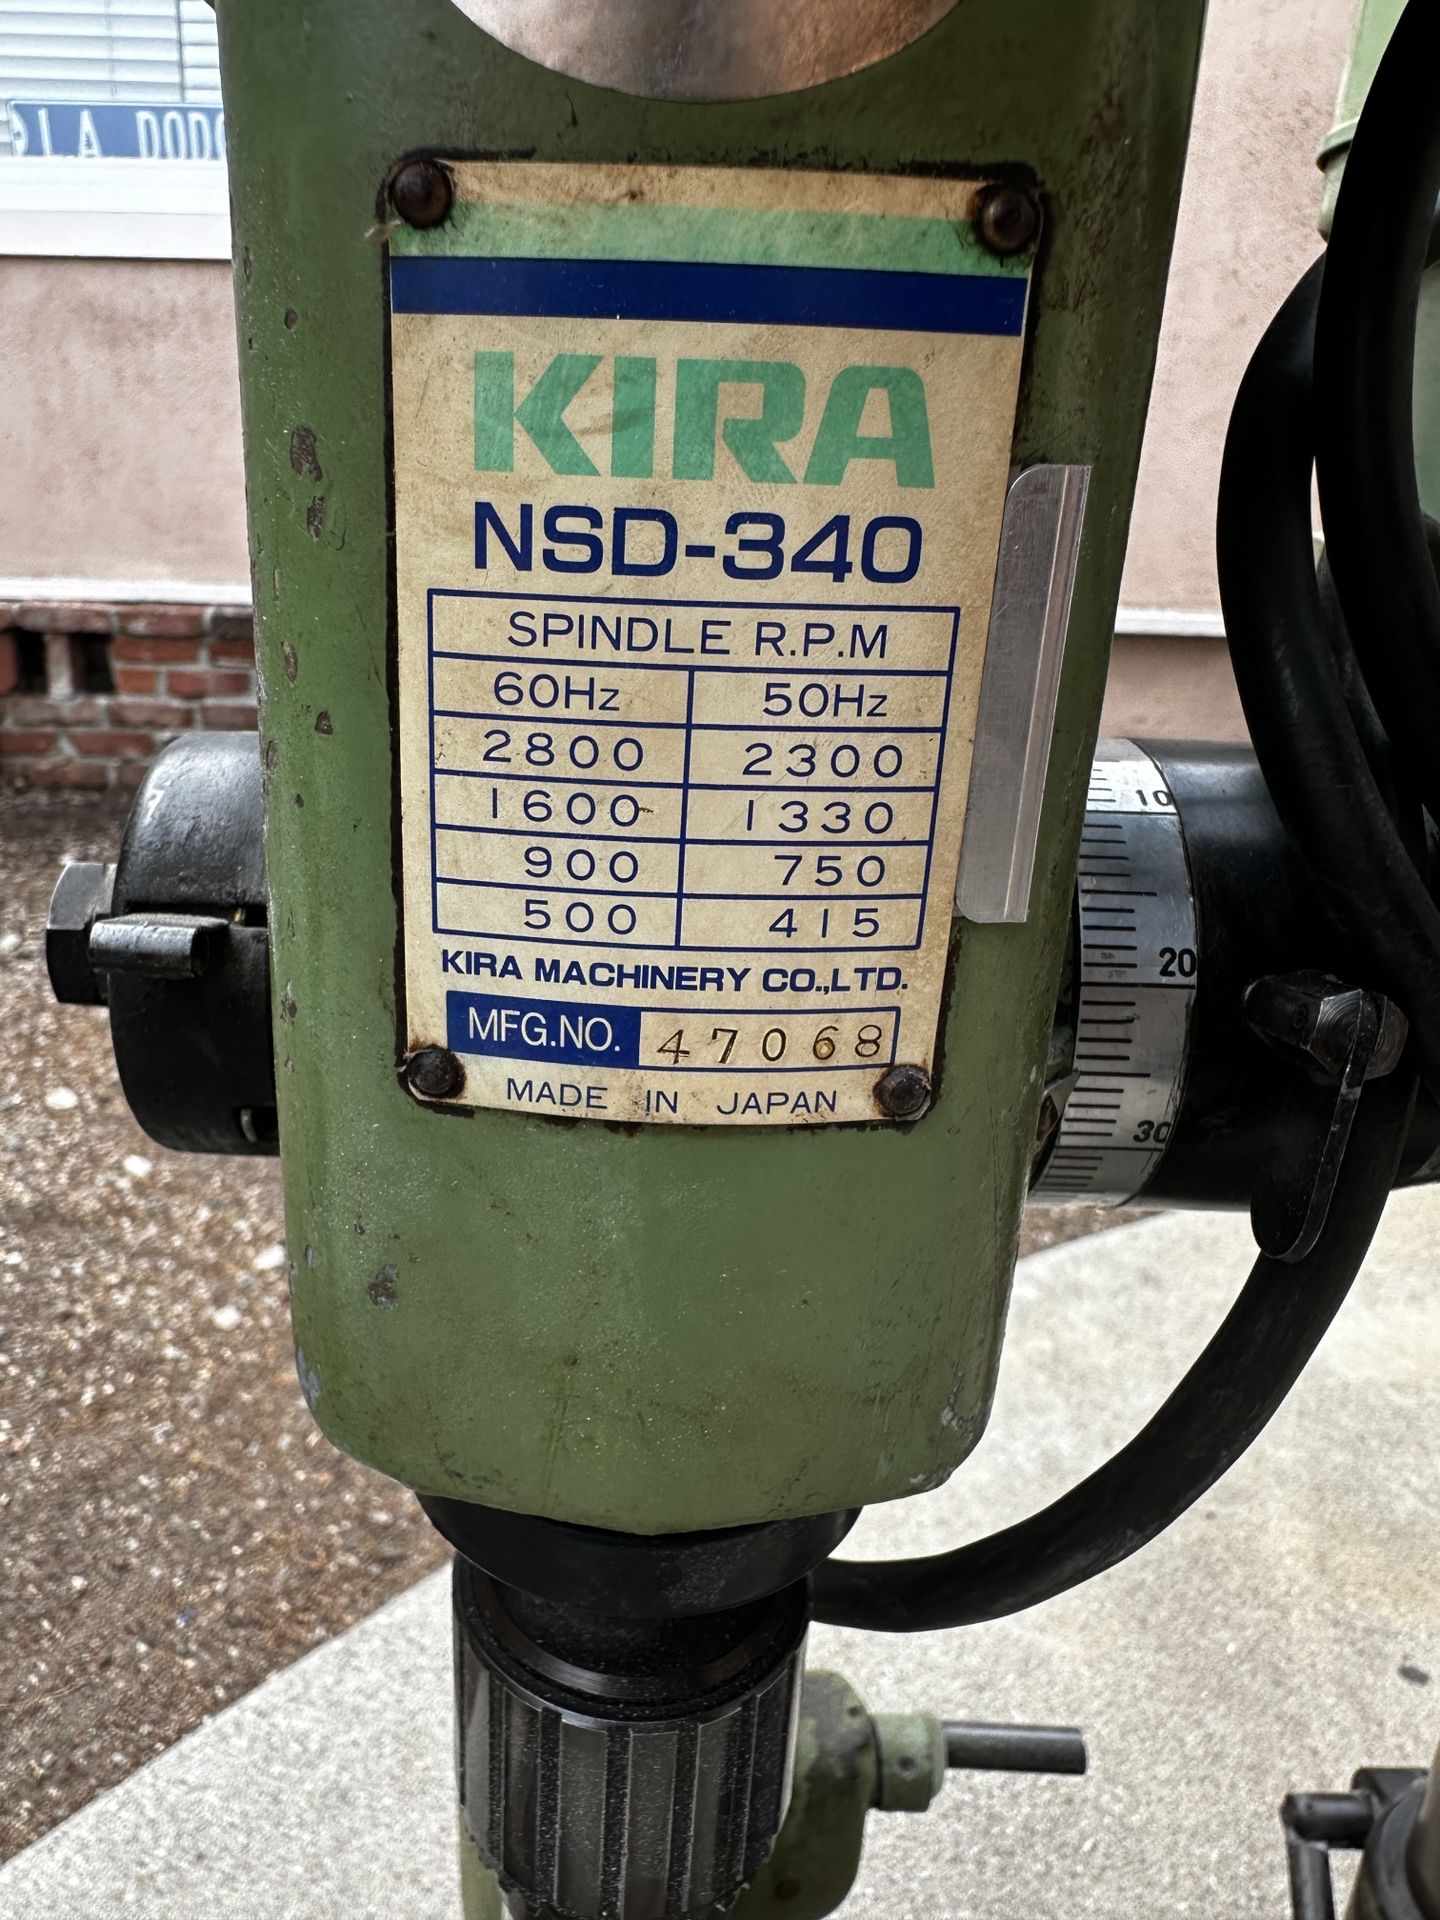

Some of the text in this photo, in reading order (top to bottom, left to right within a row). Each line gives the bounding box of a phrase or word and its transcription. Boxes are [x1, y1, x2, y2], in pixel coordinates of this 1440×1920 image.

[474, 350, 936, 490] KIRA
[473, 500, 924, 584] NSD-340
[508, 611, 888, 658] SPINDLE R.P.M
[493, 672, 621, 712] 60Hz
[762, 682, 889, 717] 50Hz
[482, 728, 645, 772] 2800
[740, 740, 904, 778] 2300
[489, 786, 641, 828] 1600
[744, 798, 894, 834] 1330
[1136, 788, 1172, 807] 10
[522, 845, 640, 884] 900
[772, 854, 887, 888] 750
[522, 897, 638, 936] 500
[768, 908, 881, 939] 415
[440, 949, 524, 981] KIRA
[533, 958, 753, 993] MACHINERY
[1158, 947, 1197, 978] 20
[467, 1004, 883, 1066] MFG.NO. 47068
[506, 1077, 838, 1116] MADE IN JAPAN
[1132, 1119, 1172, 1144] 30
